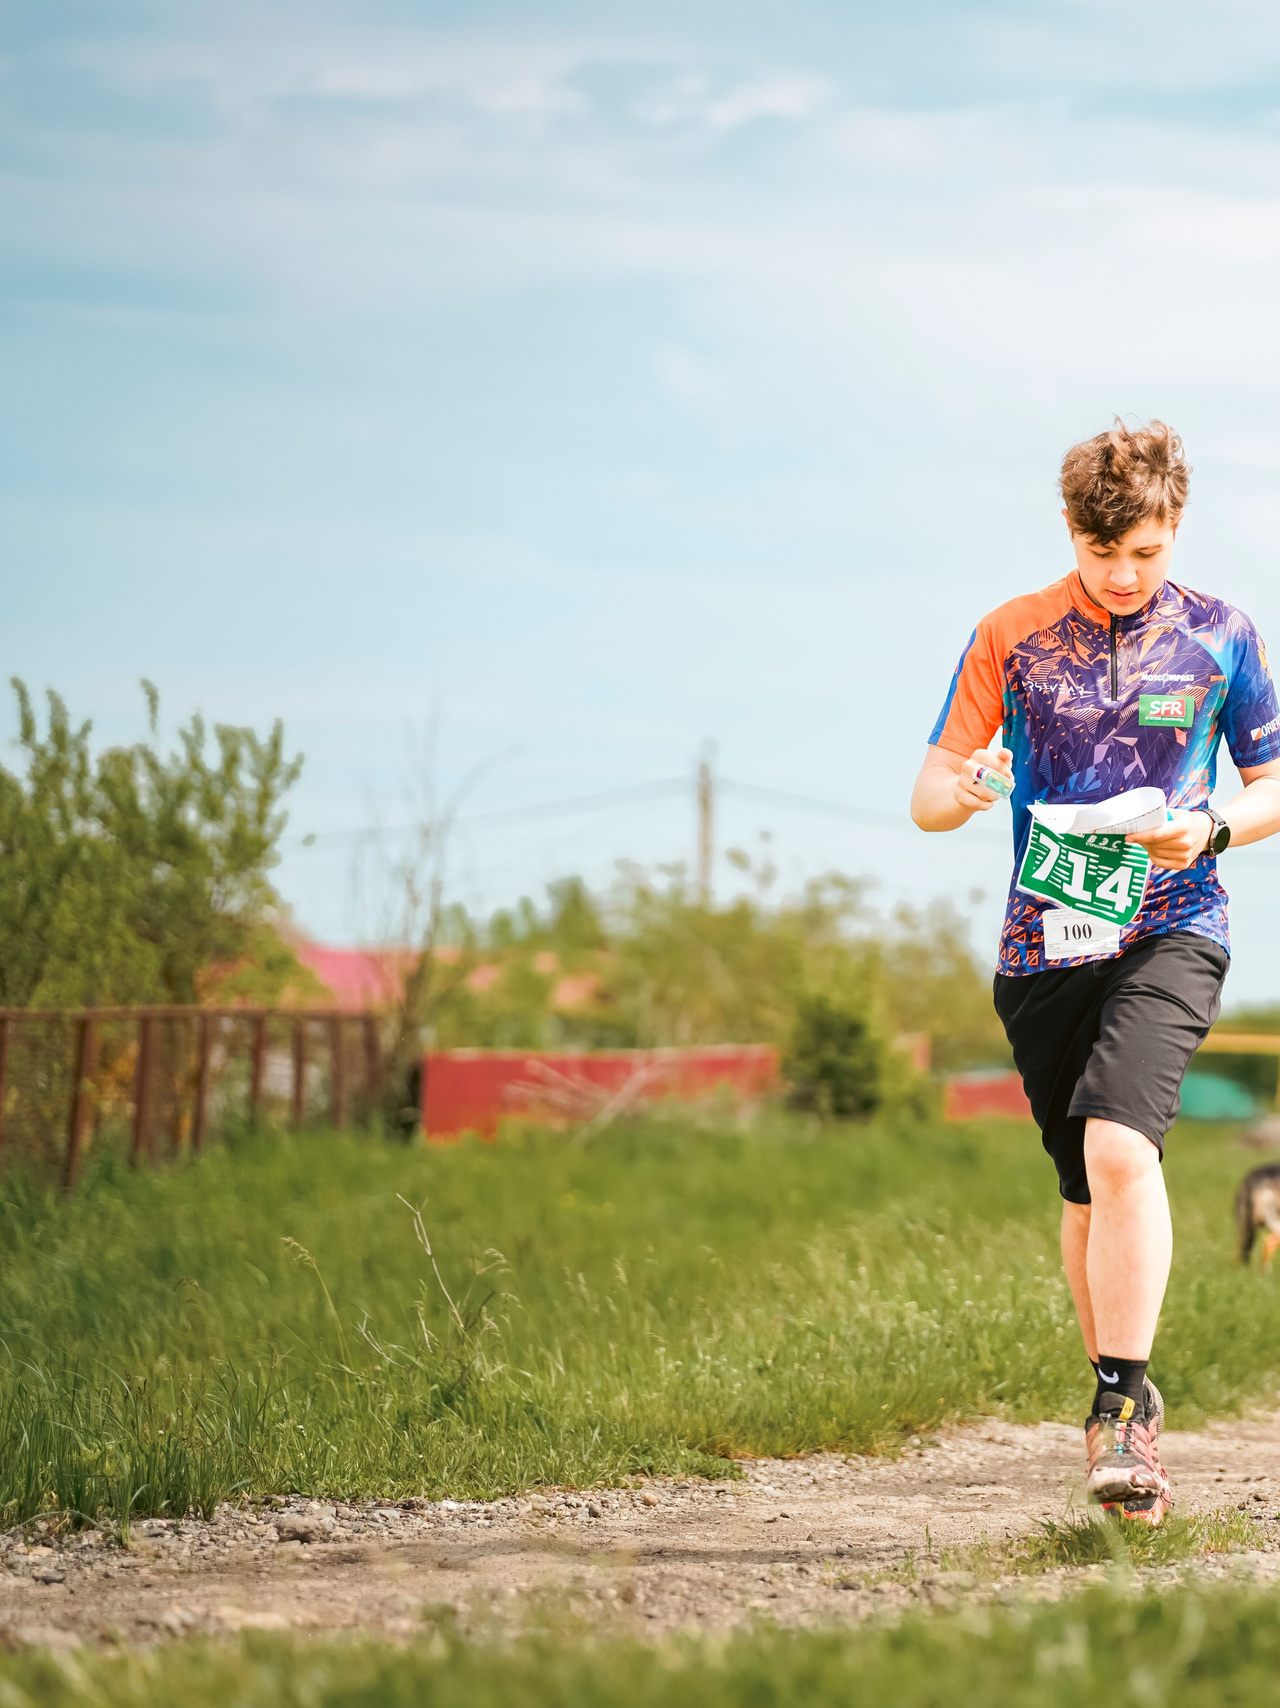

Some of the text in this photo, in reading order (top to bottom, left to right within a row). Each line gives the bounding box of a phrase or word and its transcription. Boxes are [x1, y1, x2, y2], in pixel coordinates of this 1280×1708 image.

[1150, 700, 1183, 716] SFR
[1031, 832, 1133, 914] 714
[1063, 923, 1093, 941] 100
